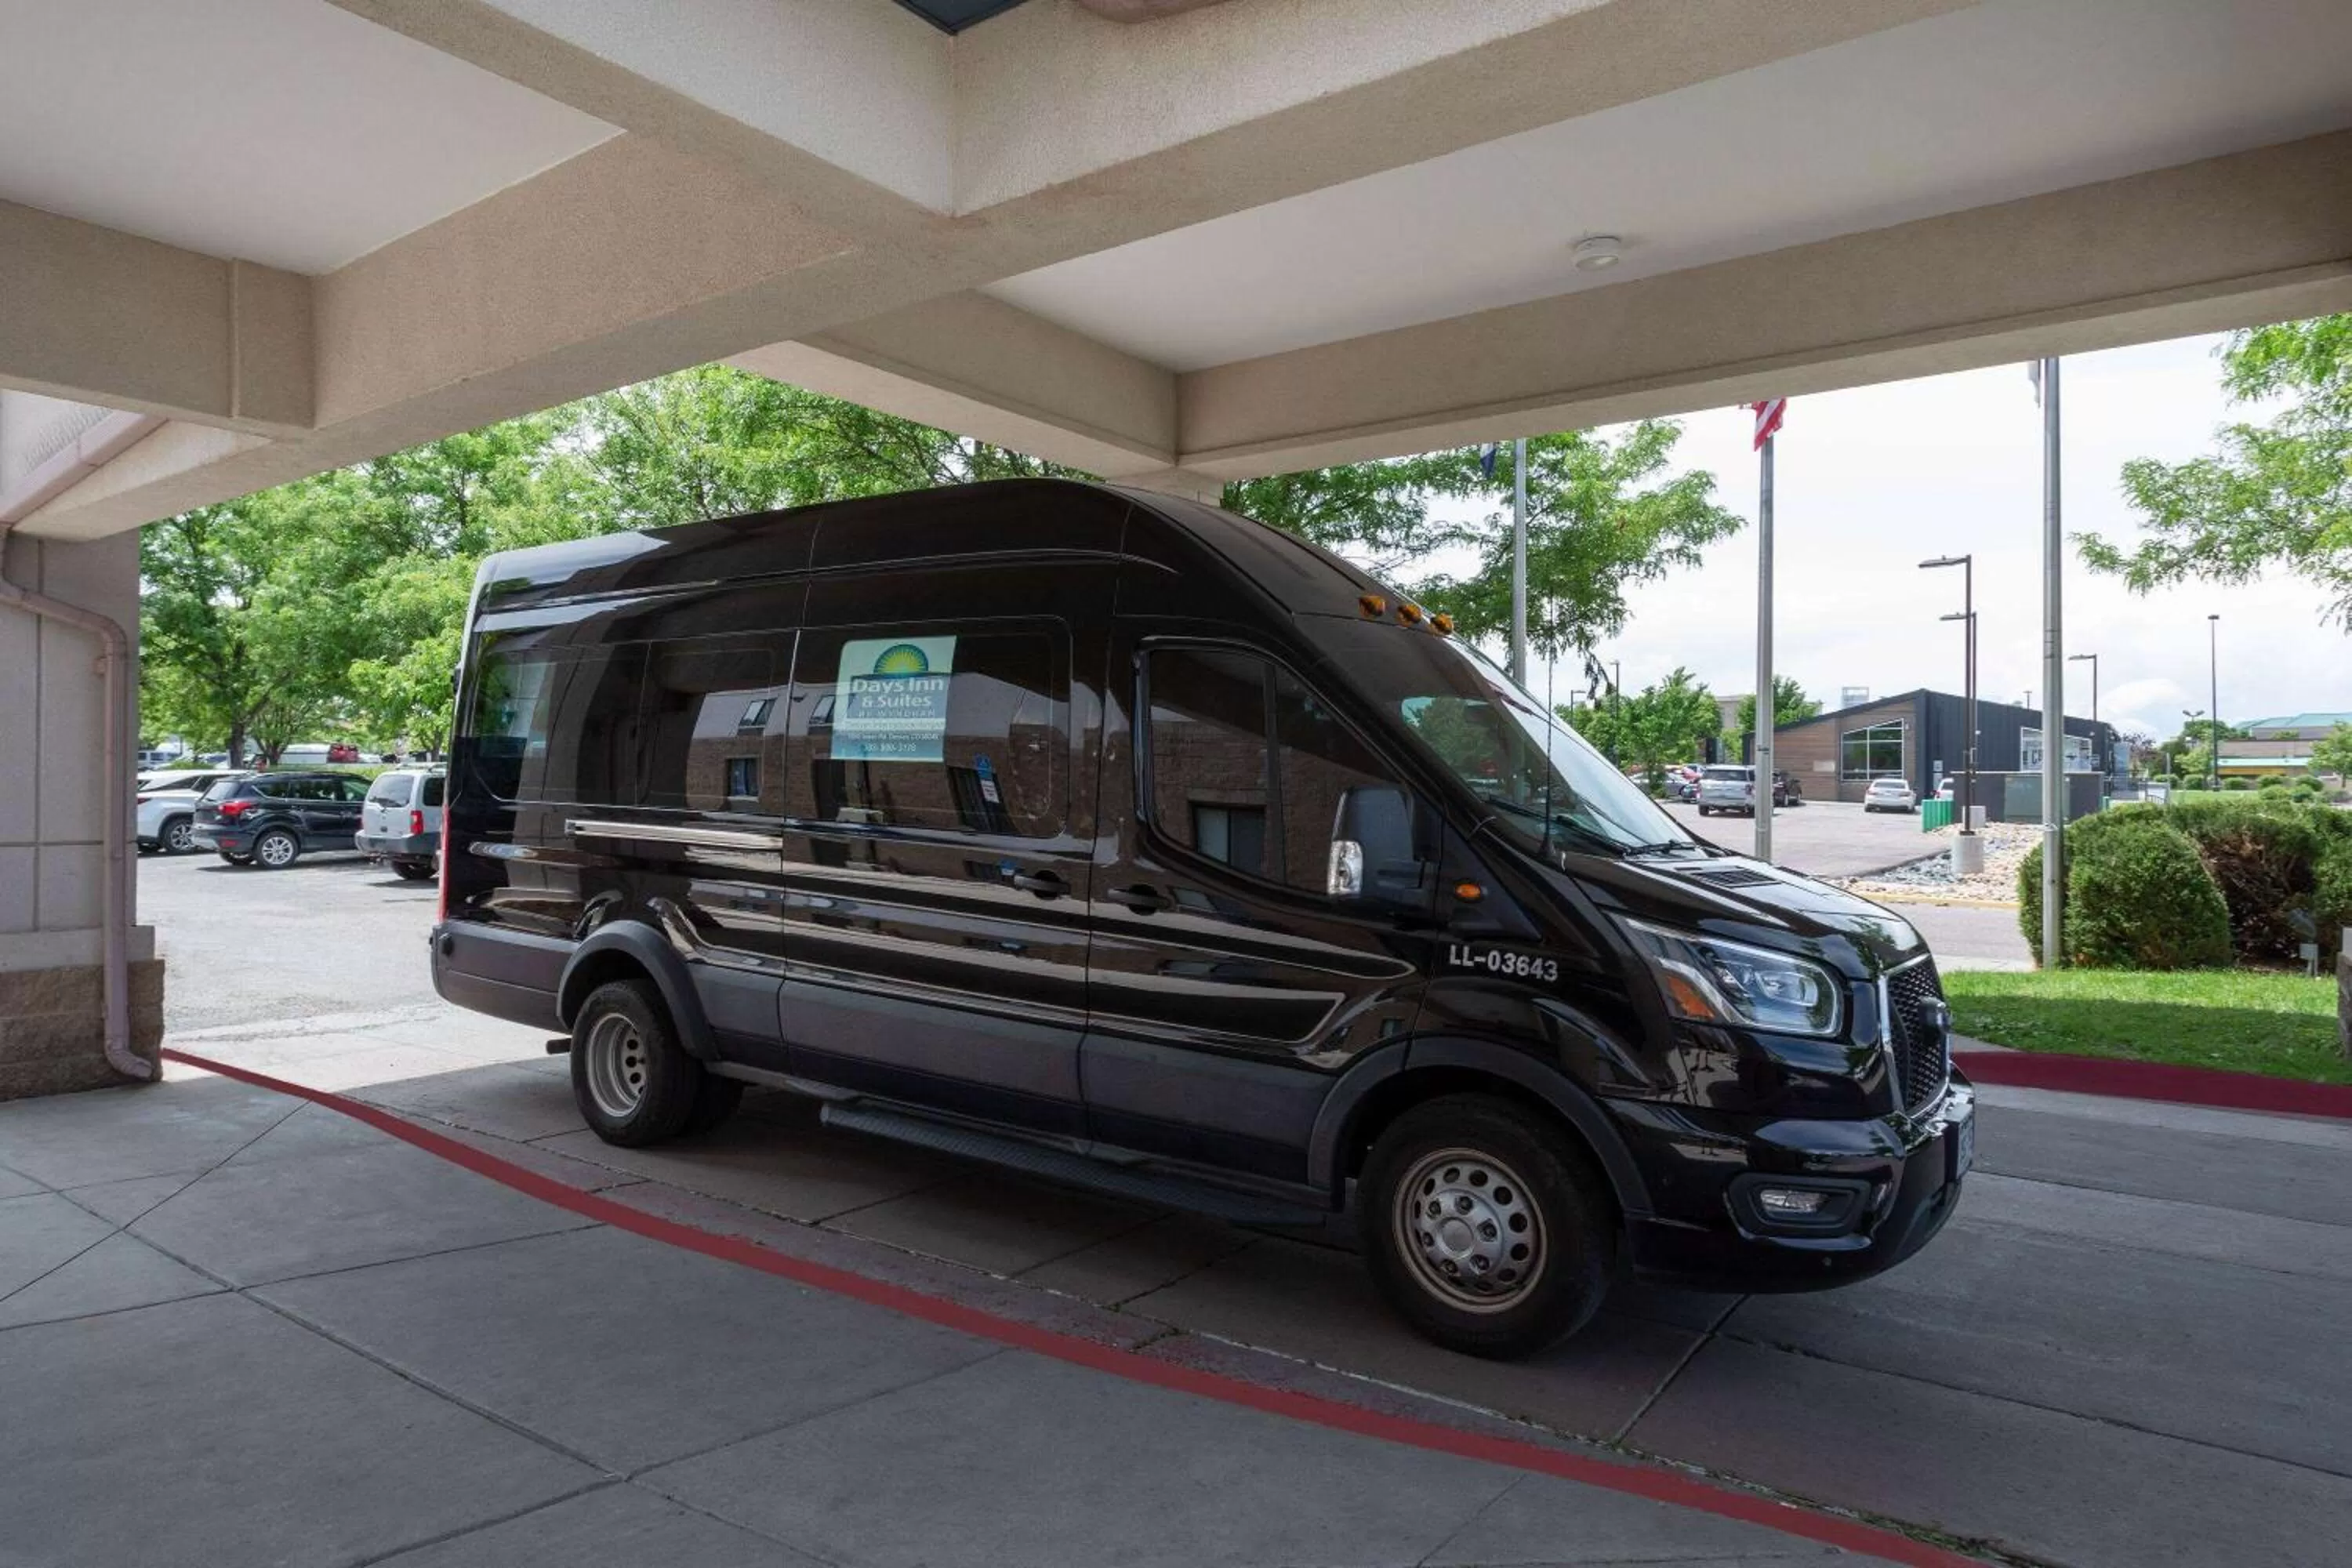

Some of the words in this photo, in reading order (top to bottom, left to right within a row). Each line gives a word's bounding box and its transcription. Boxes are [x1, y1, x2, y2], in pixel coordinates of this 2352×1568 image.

[852, 679, 904, 694] Days
[909, 677, 943, 691] Inn
[862, 696, 873, 707] &
[877, 693, 932, 707] Suites
[1450, 944, 1558, 981] LL-03643
